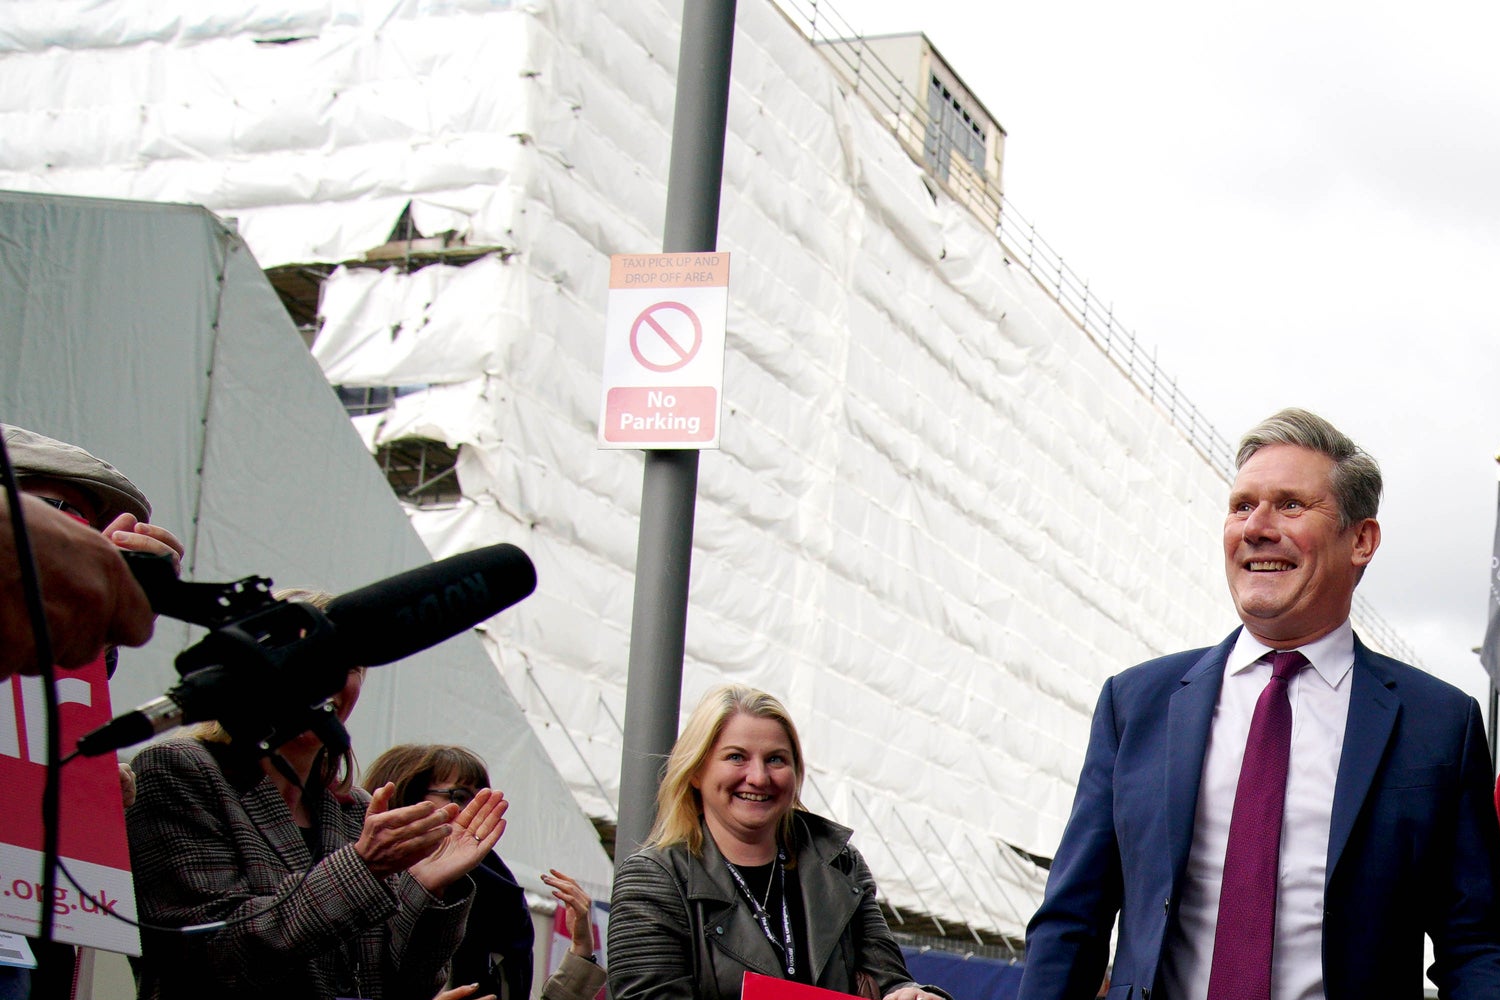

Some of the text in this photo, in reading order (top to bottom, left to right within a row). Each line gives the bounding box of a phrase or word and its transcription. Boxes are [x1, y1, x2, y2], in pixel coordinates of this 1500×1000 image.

[622, 256, 719, 269] TAXI PICK UP AND
[624, 271, 714, 284] DROP OFF AREA
[647, 392, 676, 408] No
[620, 413, 701, 434] Parking
